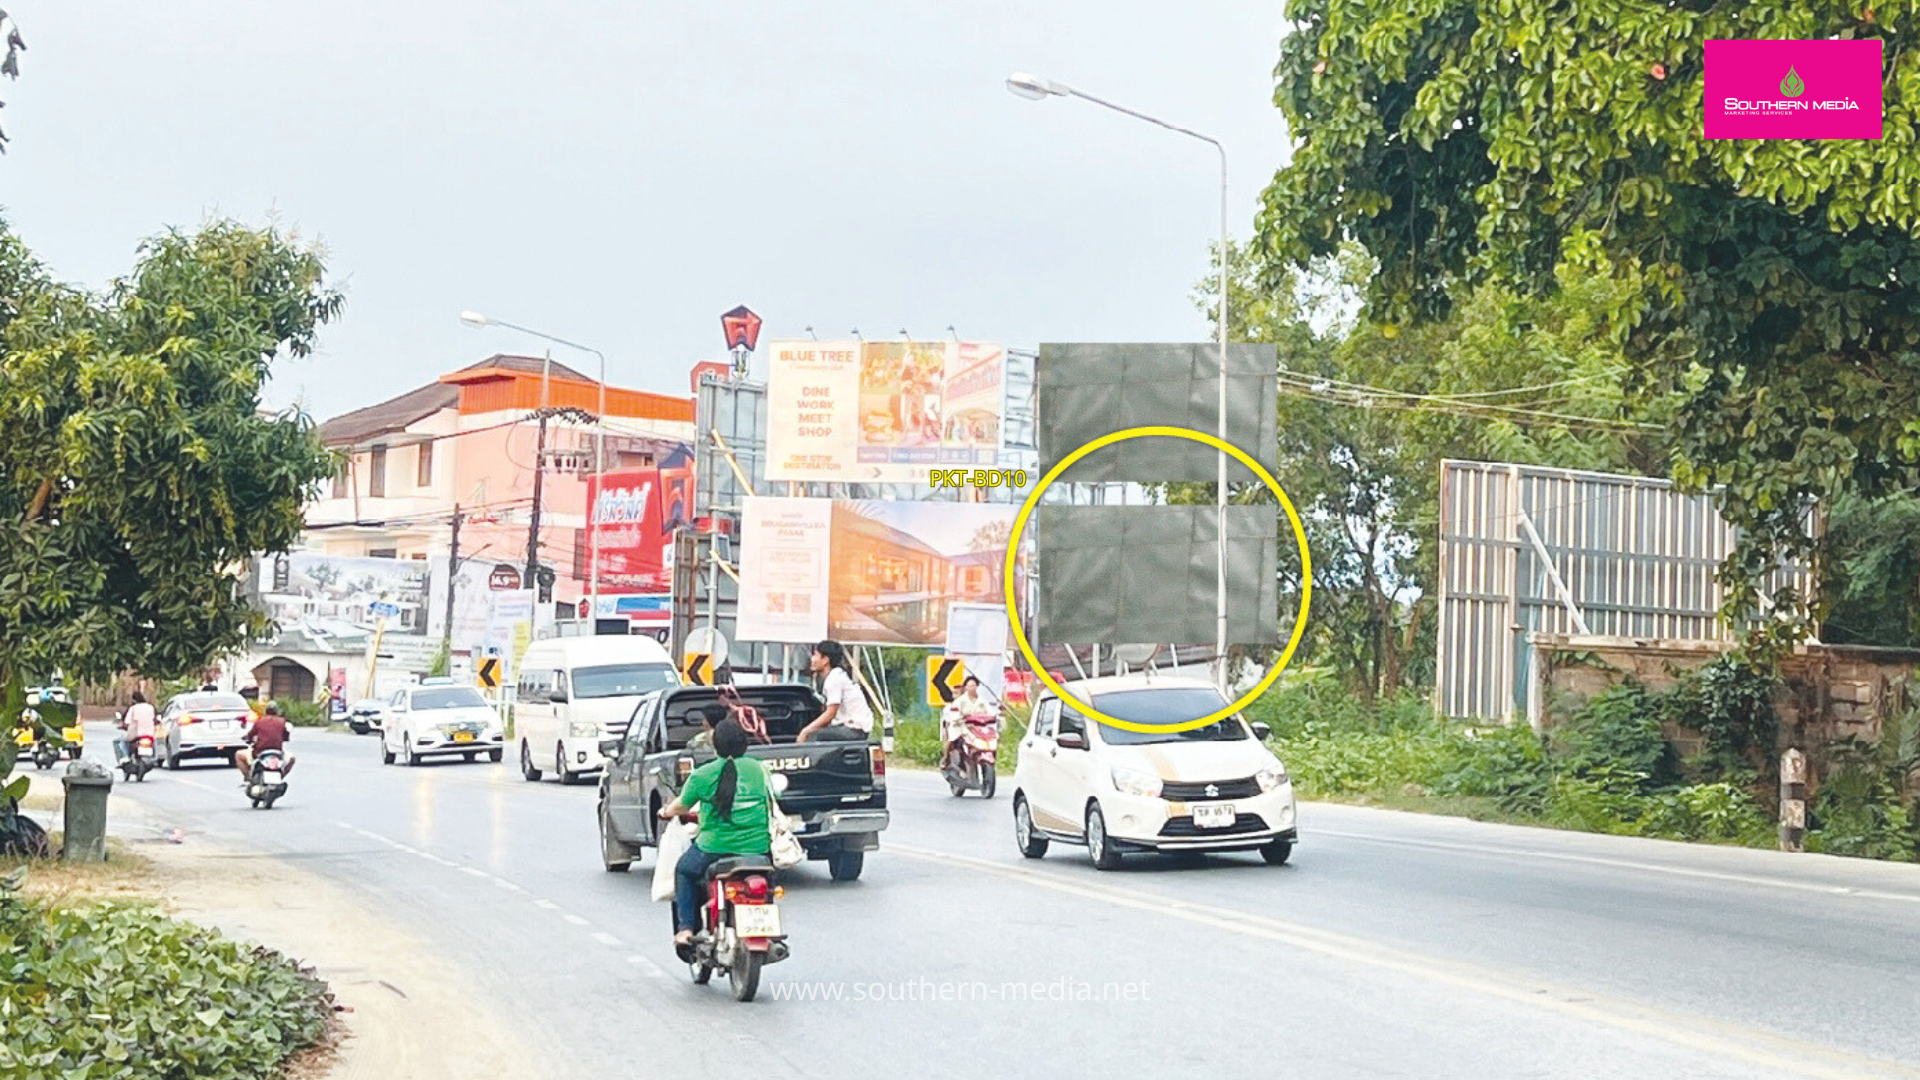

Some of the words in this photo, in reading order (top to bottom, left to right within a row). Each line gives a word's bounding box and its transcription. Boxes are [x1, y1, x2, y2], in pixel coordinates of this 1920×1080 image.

[780, 350, 816, 362] BLUE
[819, 350, 855, 363] TREE
[802, 386, 831, 398] DINE
[797, 400, 834, 410] WORK
[798, 413, 832, 424] MEET
[797, 426, 832, 437] SHOP
